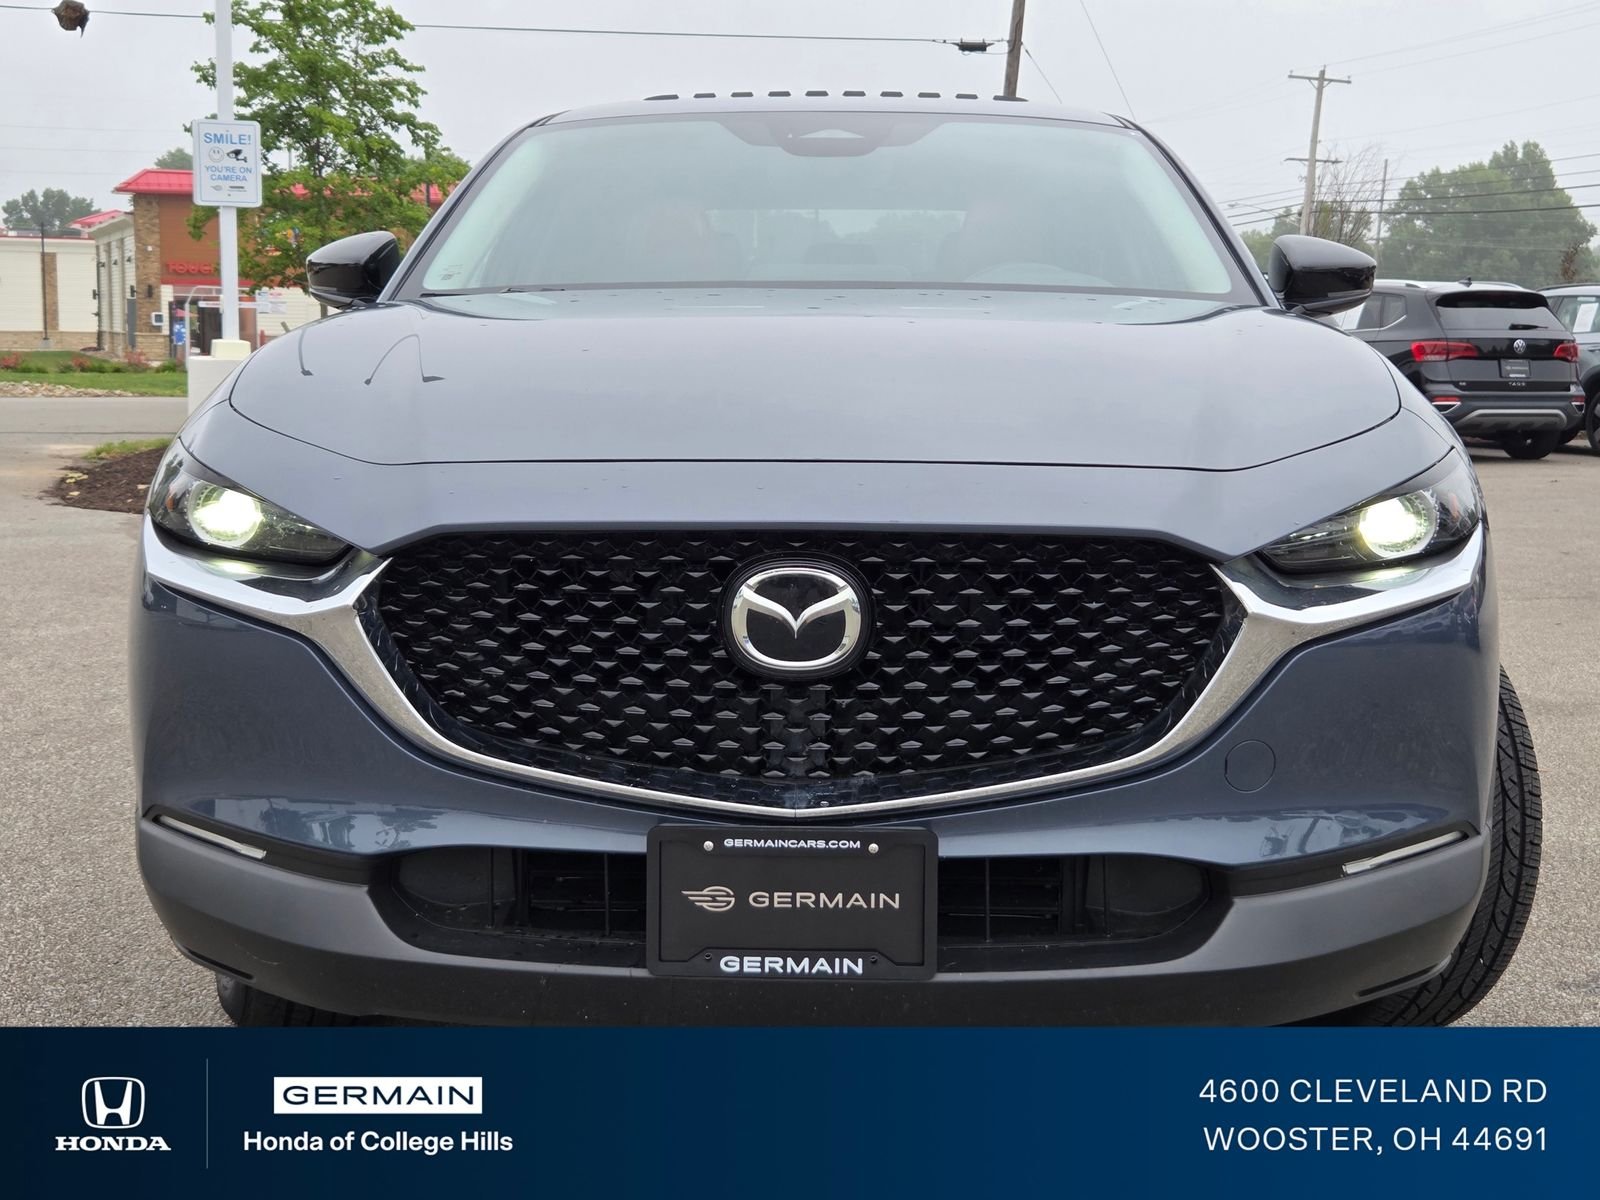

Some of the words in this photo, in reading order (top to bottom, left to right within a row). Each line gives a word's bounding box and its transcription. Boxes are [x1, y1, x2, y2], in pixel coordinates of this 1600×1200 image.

[203, 132, 252, 145] SMILE!
[205, 165, 237, 174] YOU'RE
[240, 166, 252, 174] ON
[210, 174, 247, 182] CAMERA
[723, 838, 861, 849] GERMAINCARS.COM
[748, 891, 900, 909] GERMAIN
[719, 955, 863, 975] GERMAIN
